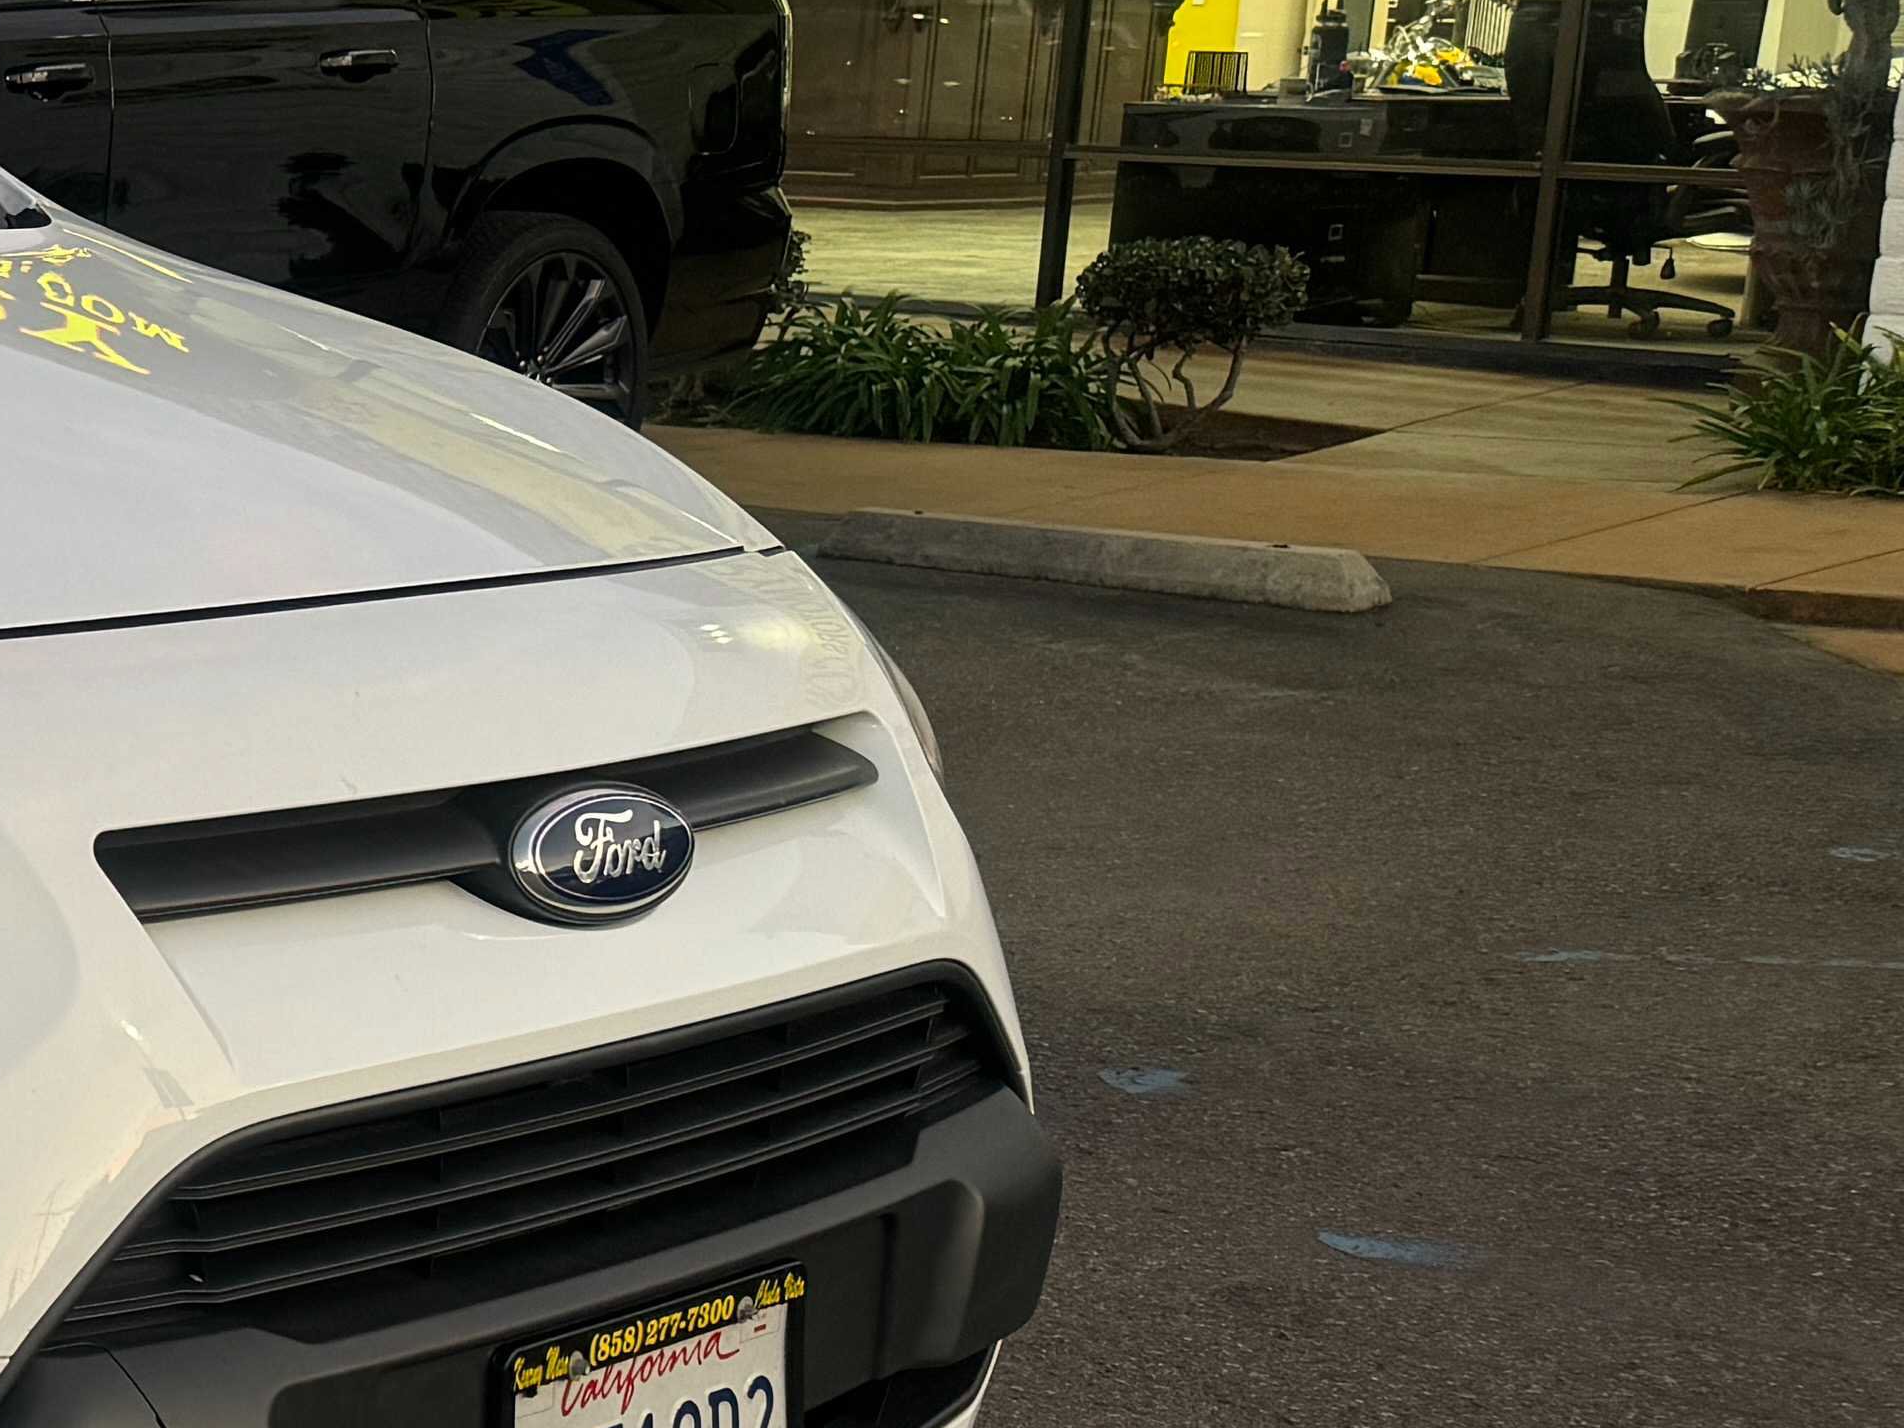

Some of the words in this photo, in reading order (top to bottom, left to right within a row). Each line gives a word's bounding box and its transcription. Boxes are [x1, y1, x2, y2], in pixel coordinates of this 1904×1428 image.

[573, 809, 667, 884] Ford
[590, 1321, 644, 1366] (858)
[645, 1294, 735, 1346] 277-7300
[561, 1329, 740, 1417] California
